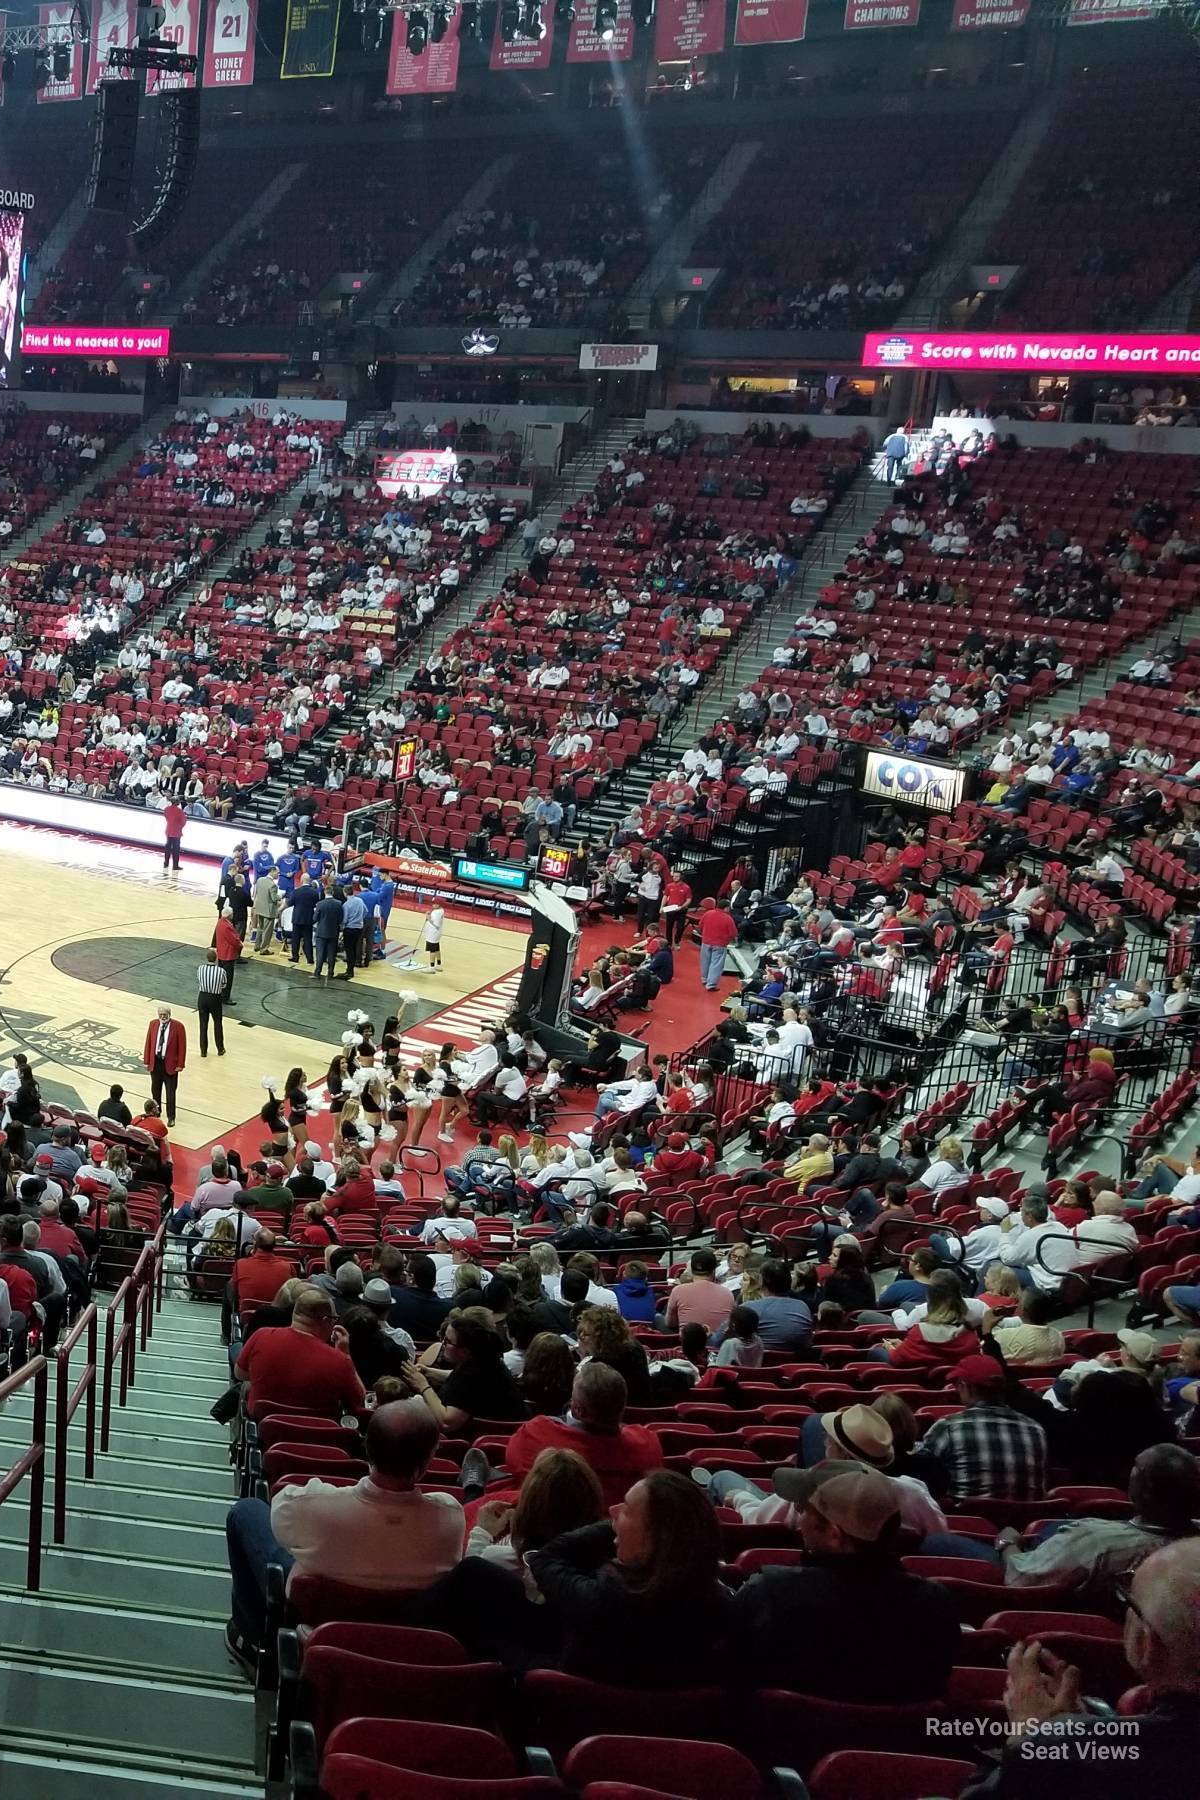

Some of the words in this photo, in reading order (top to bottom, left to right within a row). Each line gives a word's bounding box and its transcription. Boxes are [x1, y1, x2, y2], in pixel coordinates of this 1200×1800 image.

[854, 6, 909, 23] CHAMPIONS
[222, 15, 240, 38] 21
[106, 25, 118, 46] 4
[163, 25, 184, 46] 50
[214, 58, 243, 68] SIDNEY
[216, 70, 240, 81] GREEN
[44, 84, 74, 97] AUGMON
[25, 334, 49, 346] Find
[53, 335, 71, 347] the
[75, 336, 118, 348] nearest
[122, 337, 134, 348] to
[137, 336, 162, 350] you!
[921, 343, 972, 358] Score
[979, 344, 1016, 359] with
[1023, 344, 1098, 360] Nevada
[1104, 345, 1158, 361] Heart
[251, 402, 269, 416] 116
[478, 408, 500, 422] 117
[397, 752, 410, 776] 30
[877, 760, 945, 800] COX
[546, 850, 566, 862] 14:34
[54, 860, 150, 885] AMERICA
[544, 858, 560, 874] 30
[24, 1035, 63, 1050] LAS
[69, 1047, 138, 1071] VEGAS
